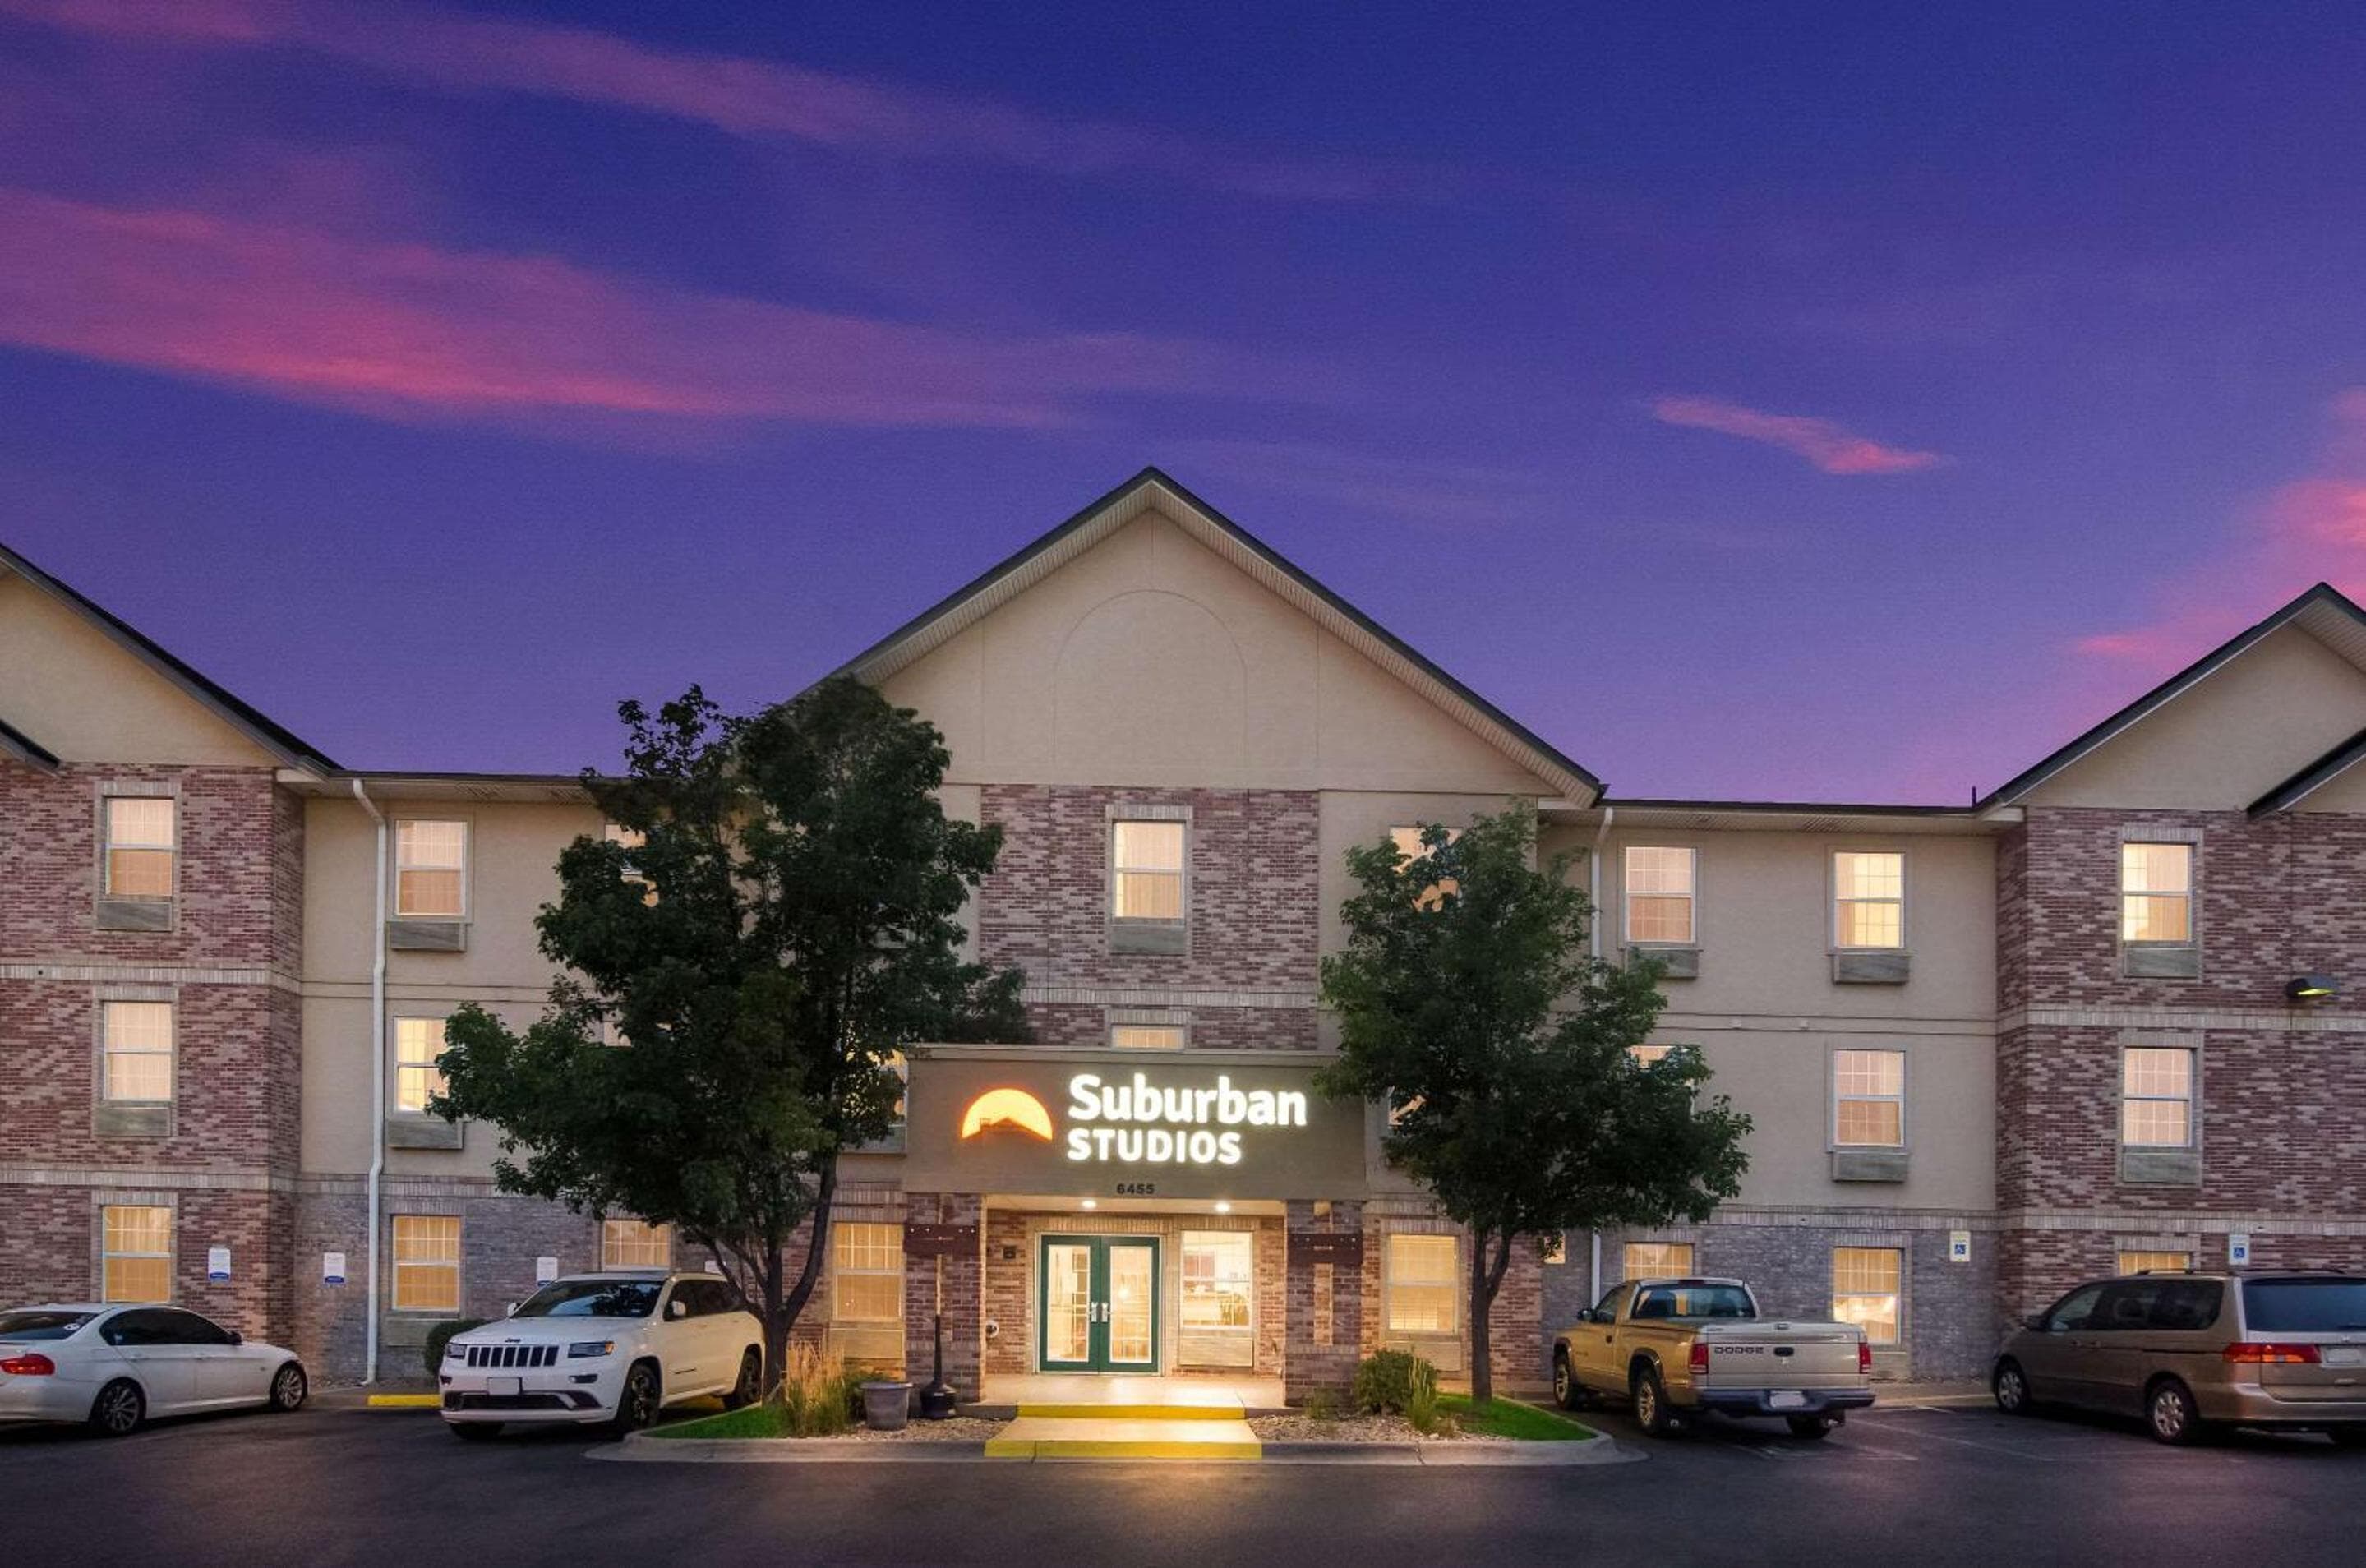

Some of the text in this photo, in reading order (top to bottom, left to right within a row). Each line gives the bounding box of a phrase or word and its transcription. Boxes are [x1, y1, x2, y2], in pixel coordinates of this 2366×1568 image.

[1068, 1072, 1308, 1126] Suburban
[1067, 1127, 1242, 1164] STUDIOS
[1117, 1183, 1155, 1195] 6455
[1714, 1346, 1764, 1354] DODGE
